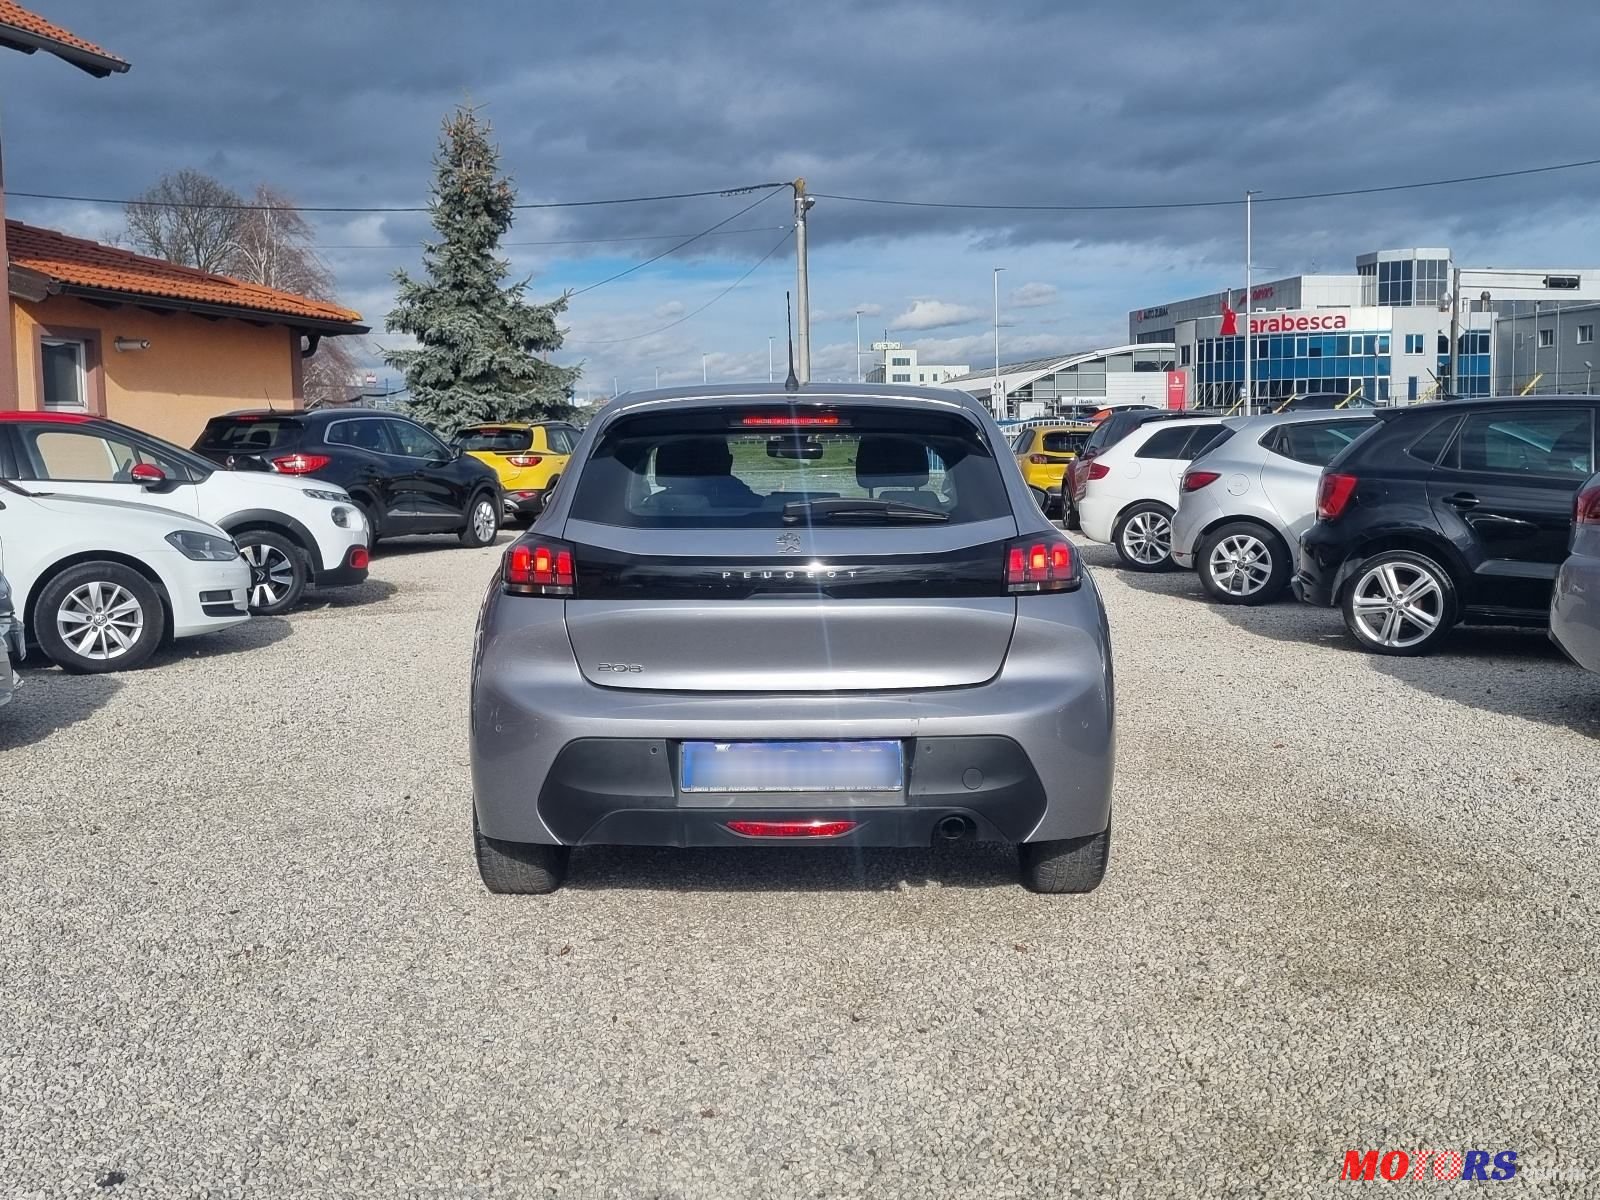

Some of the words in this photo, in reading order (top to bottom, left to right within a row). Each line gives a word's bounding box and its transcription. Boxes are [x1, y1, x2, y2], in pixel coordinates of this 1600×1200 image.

[1250, 313, 1346, 333] arabesca
[722, 571, 857, 579] PEUGEOT
[598, 662, 643, 673] 208
